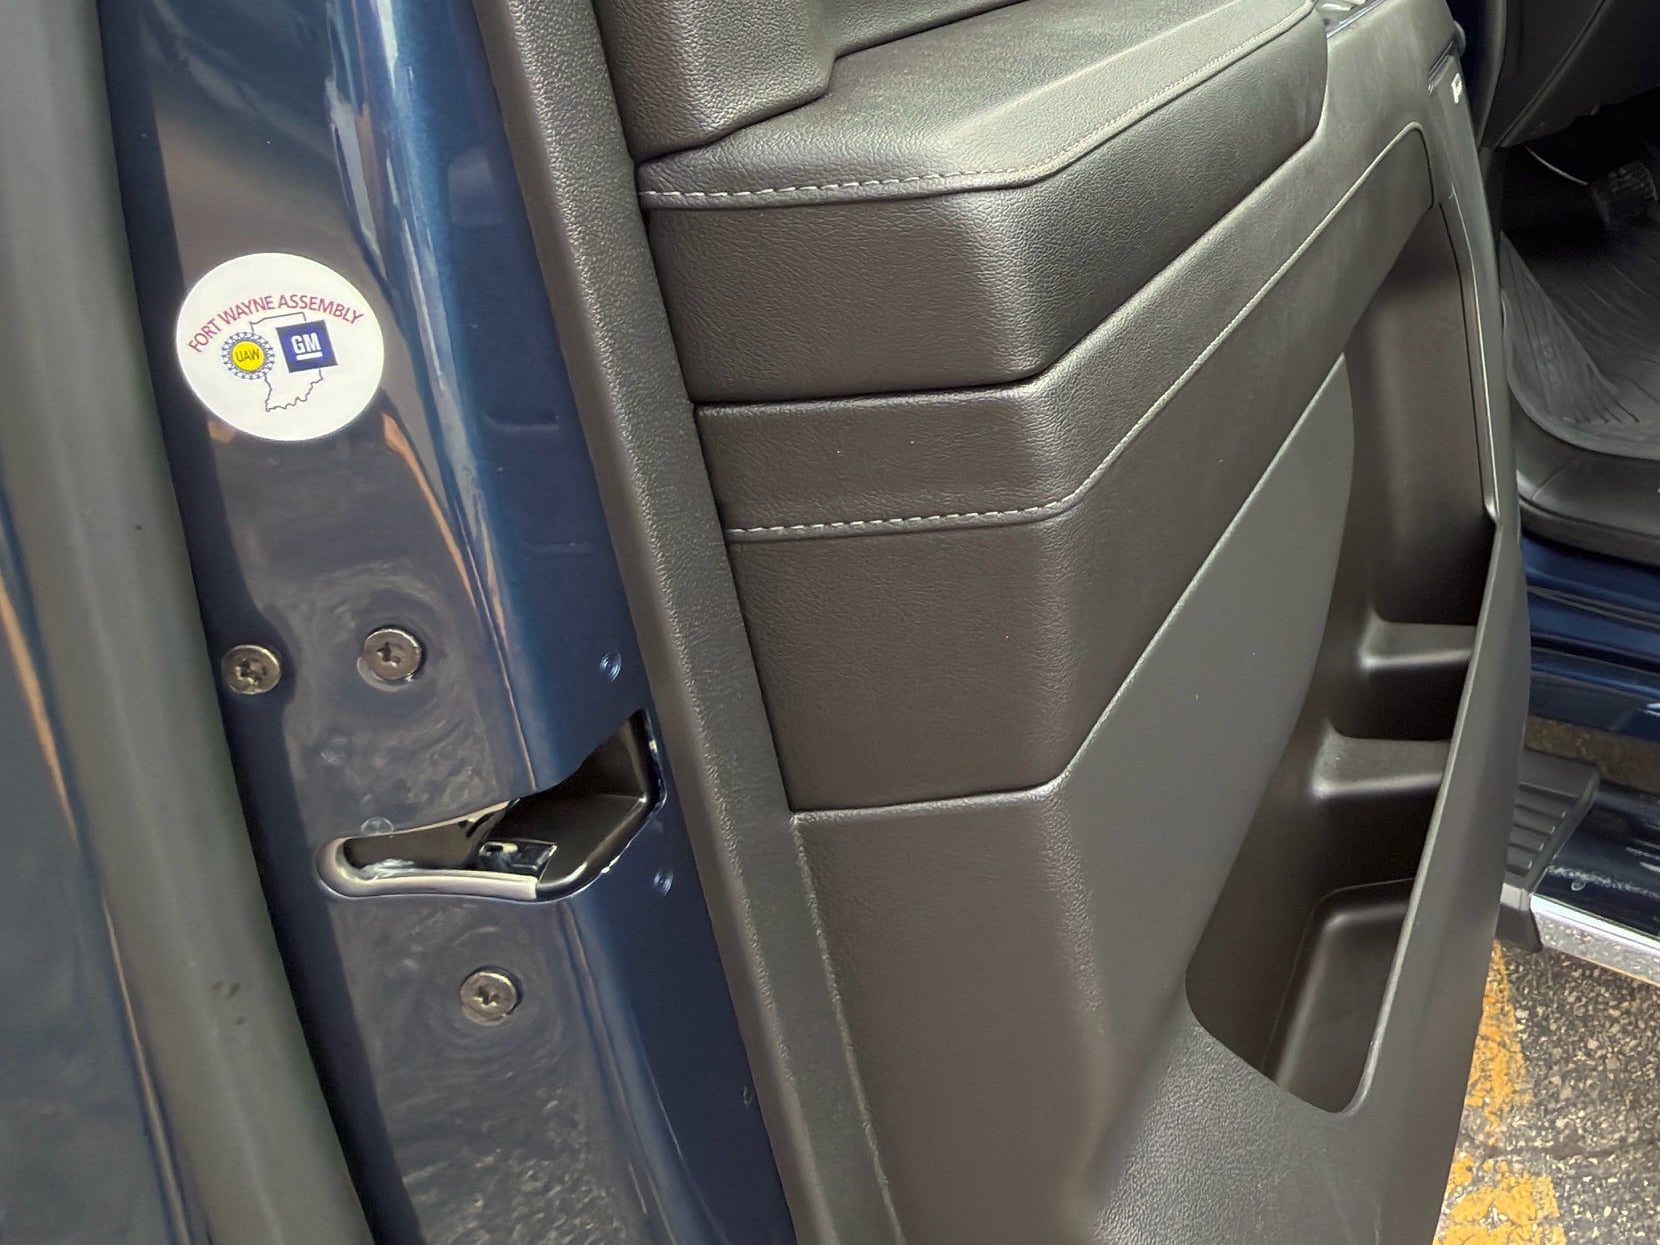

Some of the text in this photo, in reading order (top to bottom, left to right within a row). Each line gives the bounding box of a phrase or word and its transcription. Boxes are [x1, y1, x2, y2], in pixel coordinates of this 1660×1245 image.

[188, 294, 364, 352] FORT WAYNE ASSEMBLY
[291, 332, 322, 354] GM
[234, 348, 261, 363] UAW
